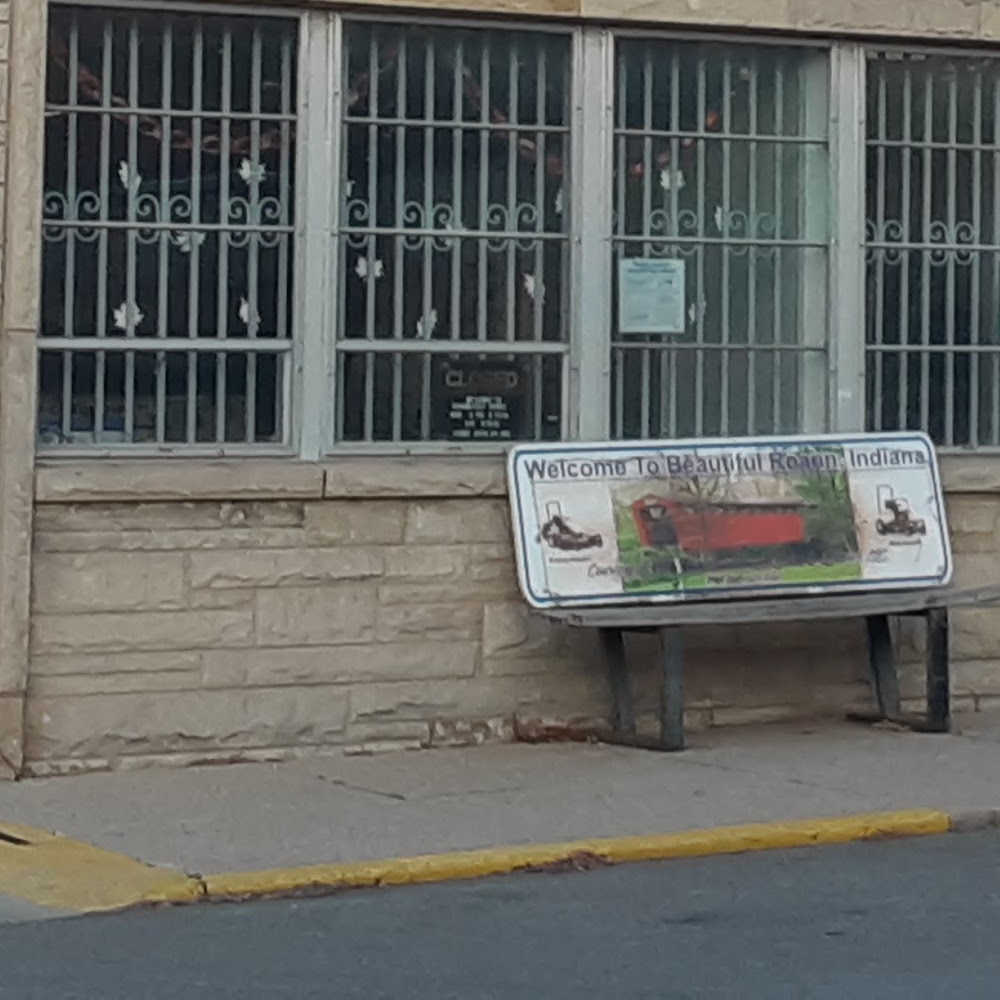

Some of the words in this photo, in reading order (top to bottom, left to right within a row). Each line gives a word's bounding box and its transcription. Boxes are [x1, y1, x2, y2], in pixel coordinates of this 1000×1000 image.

[524, 459, 627, 479] Welcome
[636, 457, 660, 475] To
[666, 452, 762, 475] Beautiful
[849, 447, 928, 468] Indiana
